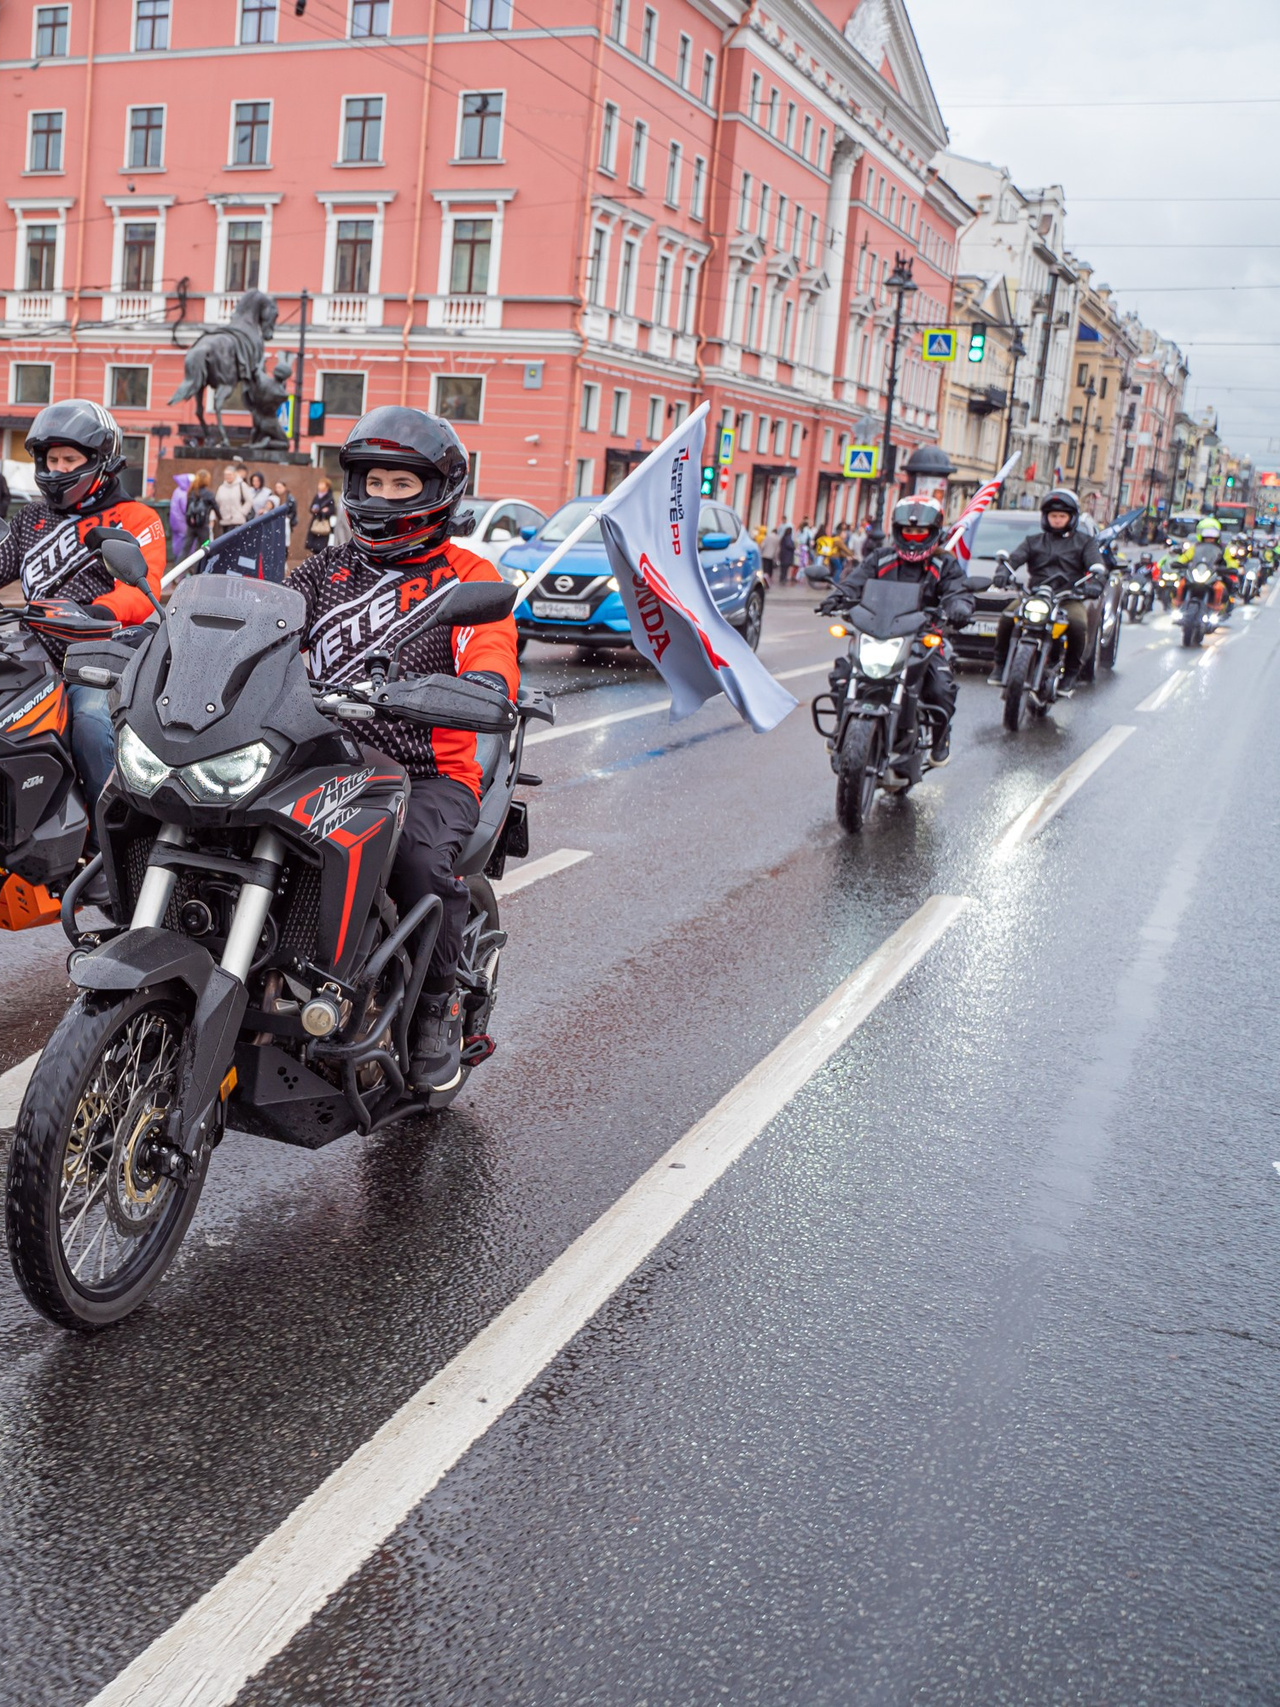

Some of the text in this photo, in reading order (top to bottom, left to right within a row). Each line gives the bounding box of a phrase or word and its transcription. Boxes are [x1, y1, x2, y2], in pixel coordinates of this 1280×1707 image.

[13, 681, 55, 722] ADVENTURE
[22, 775, 44, 790] KTM
[309, 766, 376, 829] Africa
[302, 806, 362, 844] Twin
